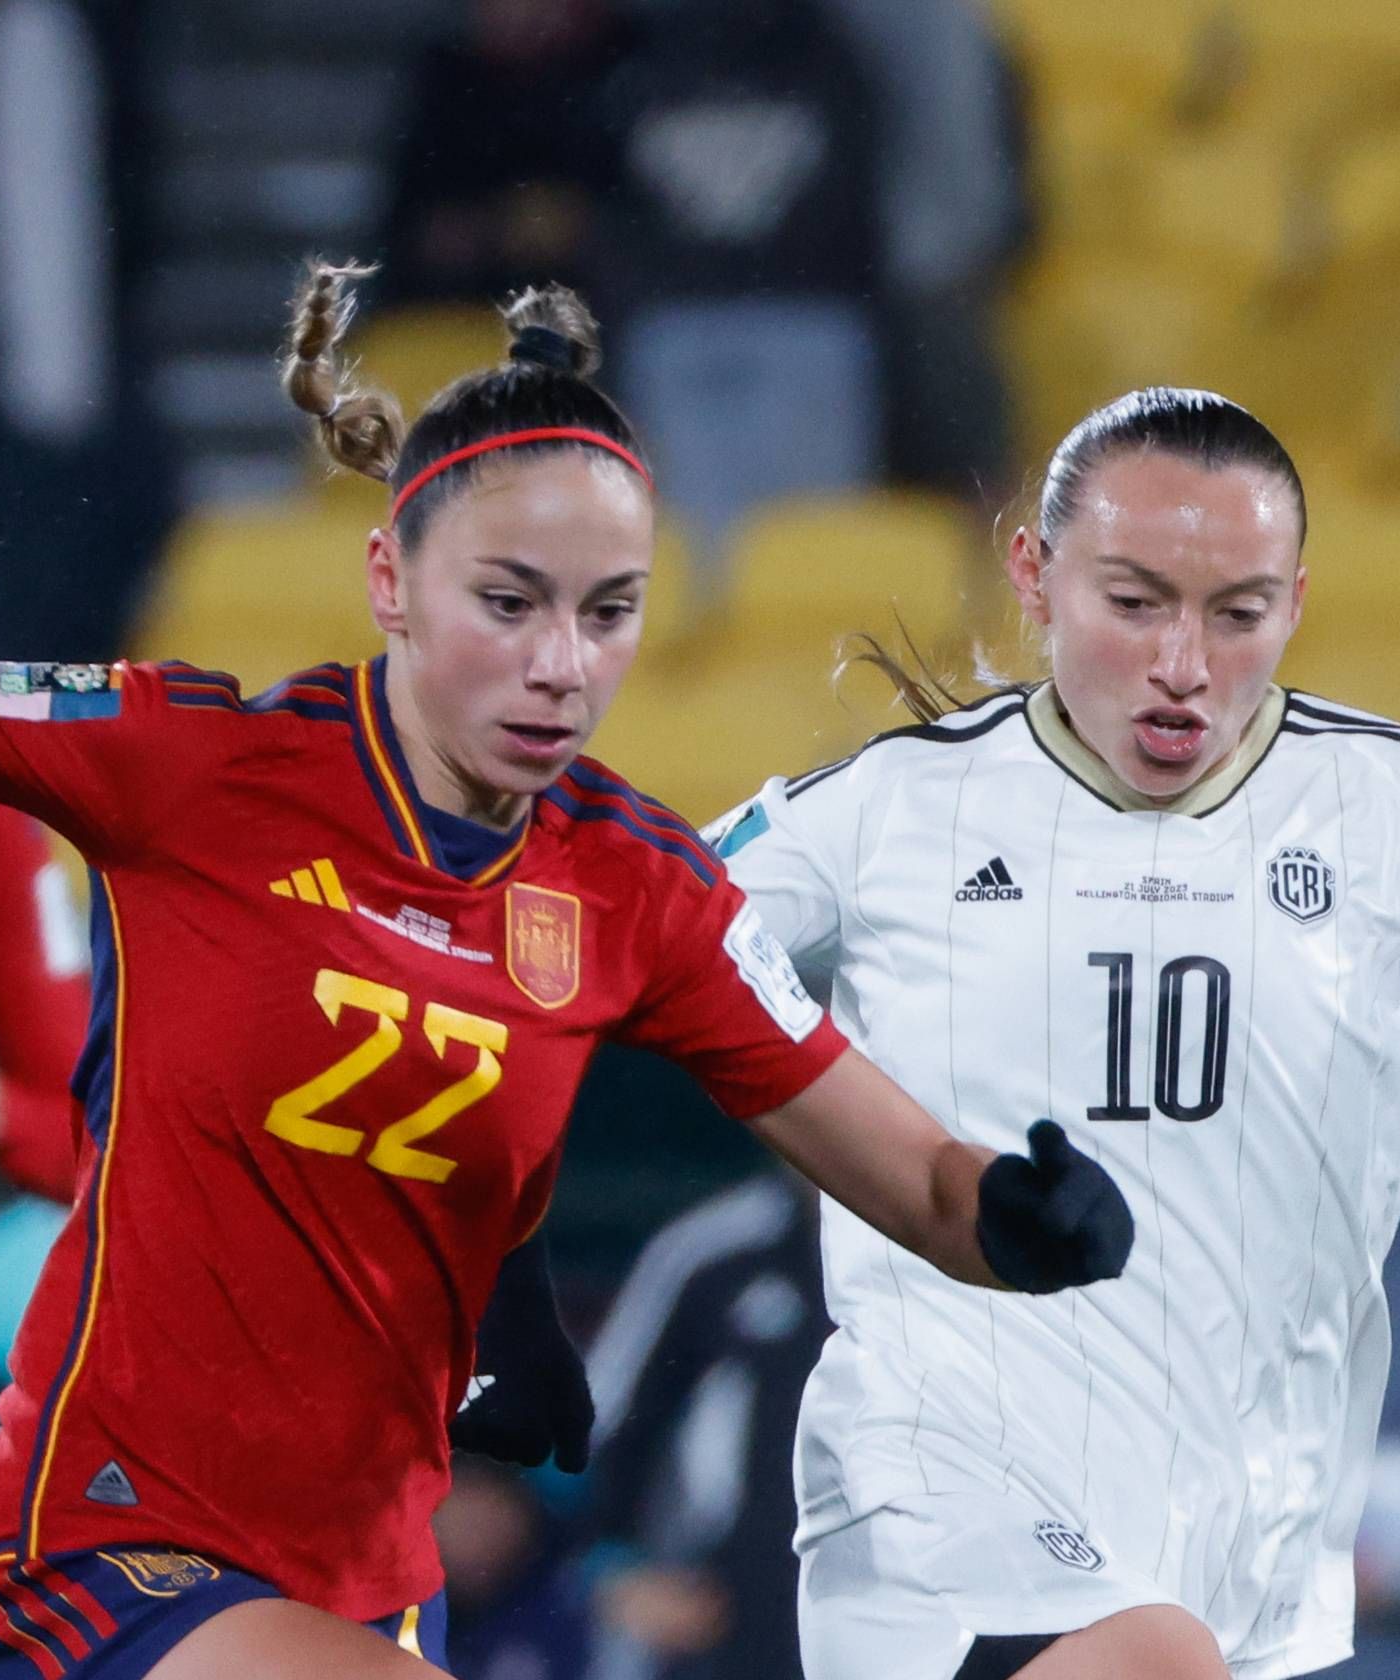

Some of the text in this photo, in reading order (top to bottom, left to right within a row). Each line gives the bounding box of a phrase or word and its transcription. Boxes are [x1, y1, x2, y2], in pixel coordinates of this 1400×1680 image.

[1124, 882, 1135, 891] 21
[1138, 884, 1161, 894] JULY
[1141, 875, 1172, 886] SPAIN
[955, 884, 1024, 902] adidas
[1076, 888, 1234, 902] WELLINGTON REGIONAL STADIUM
[1087, 952, 1232, 1122] 10
[265, 968, 509, 1184] 22
